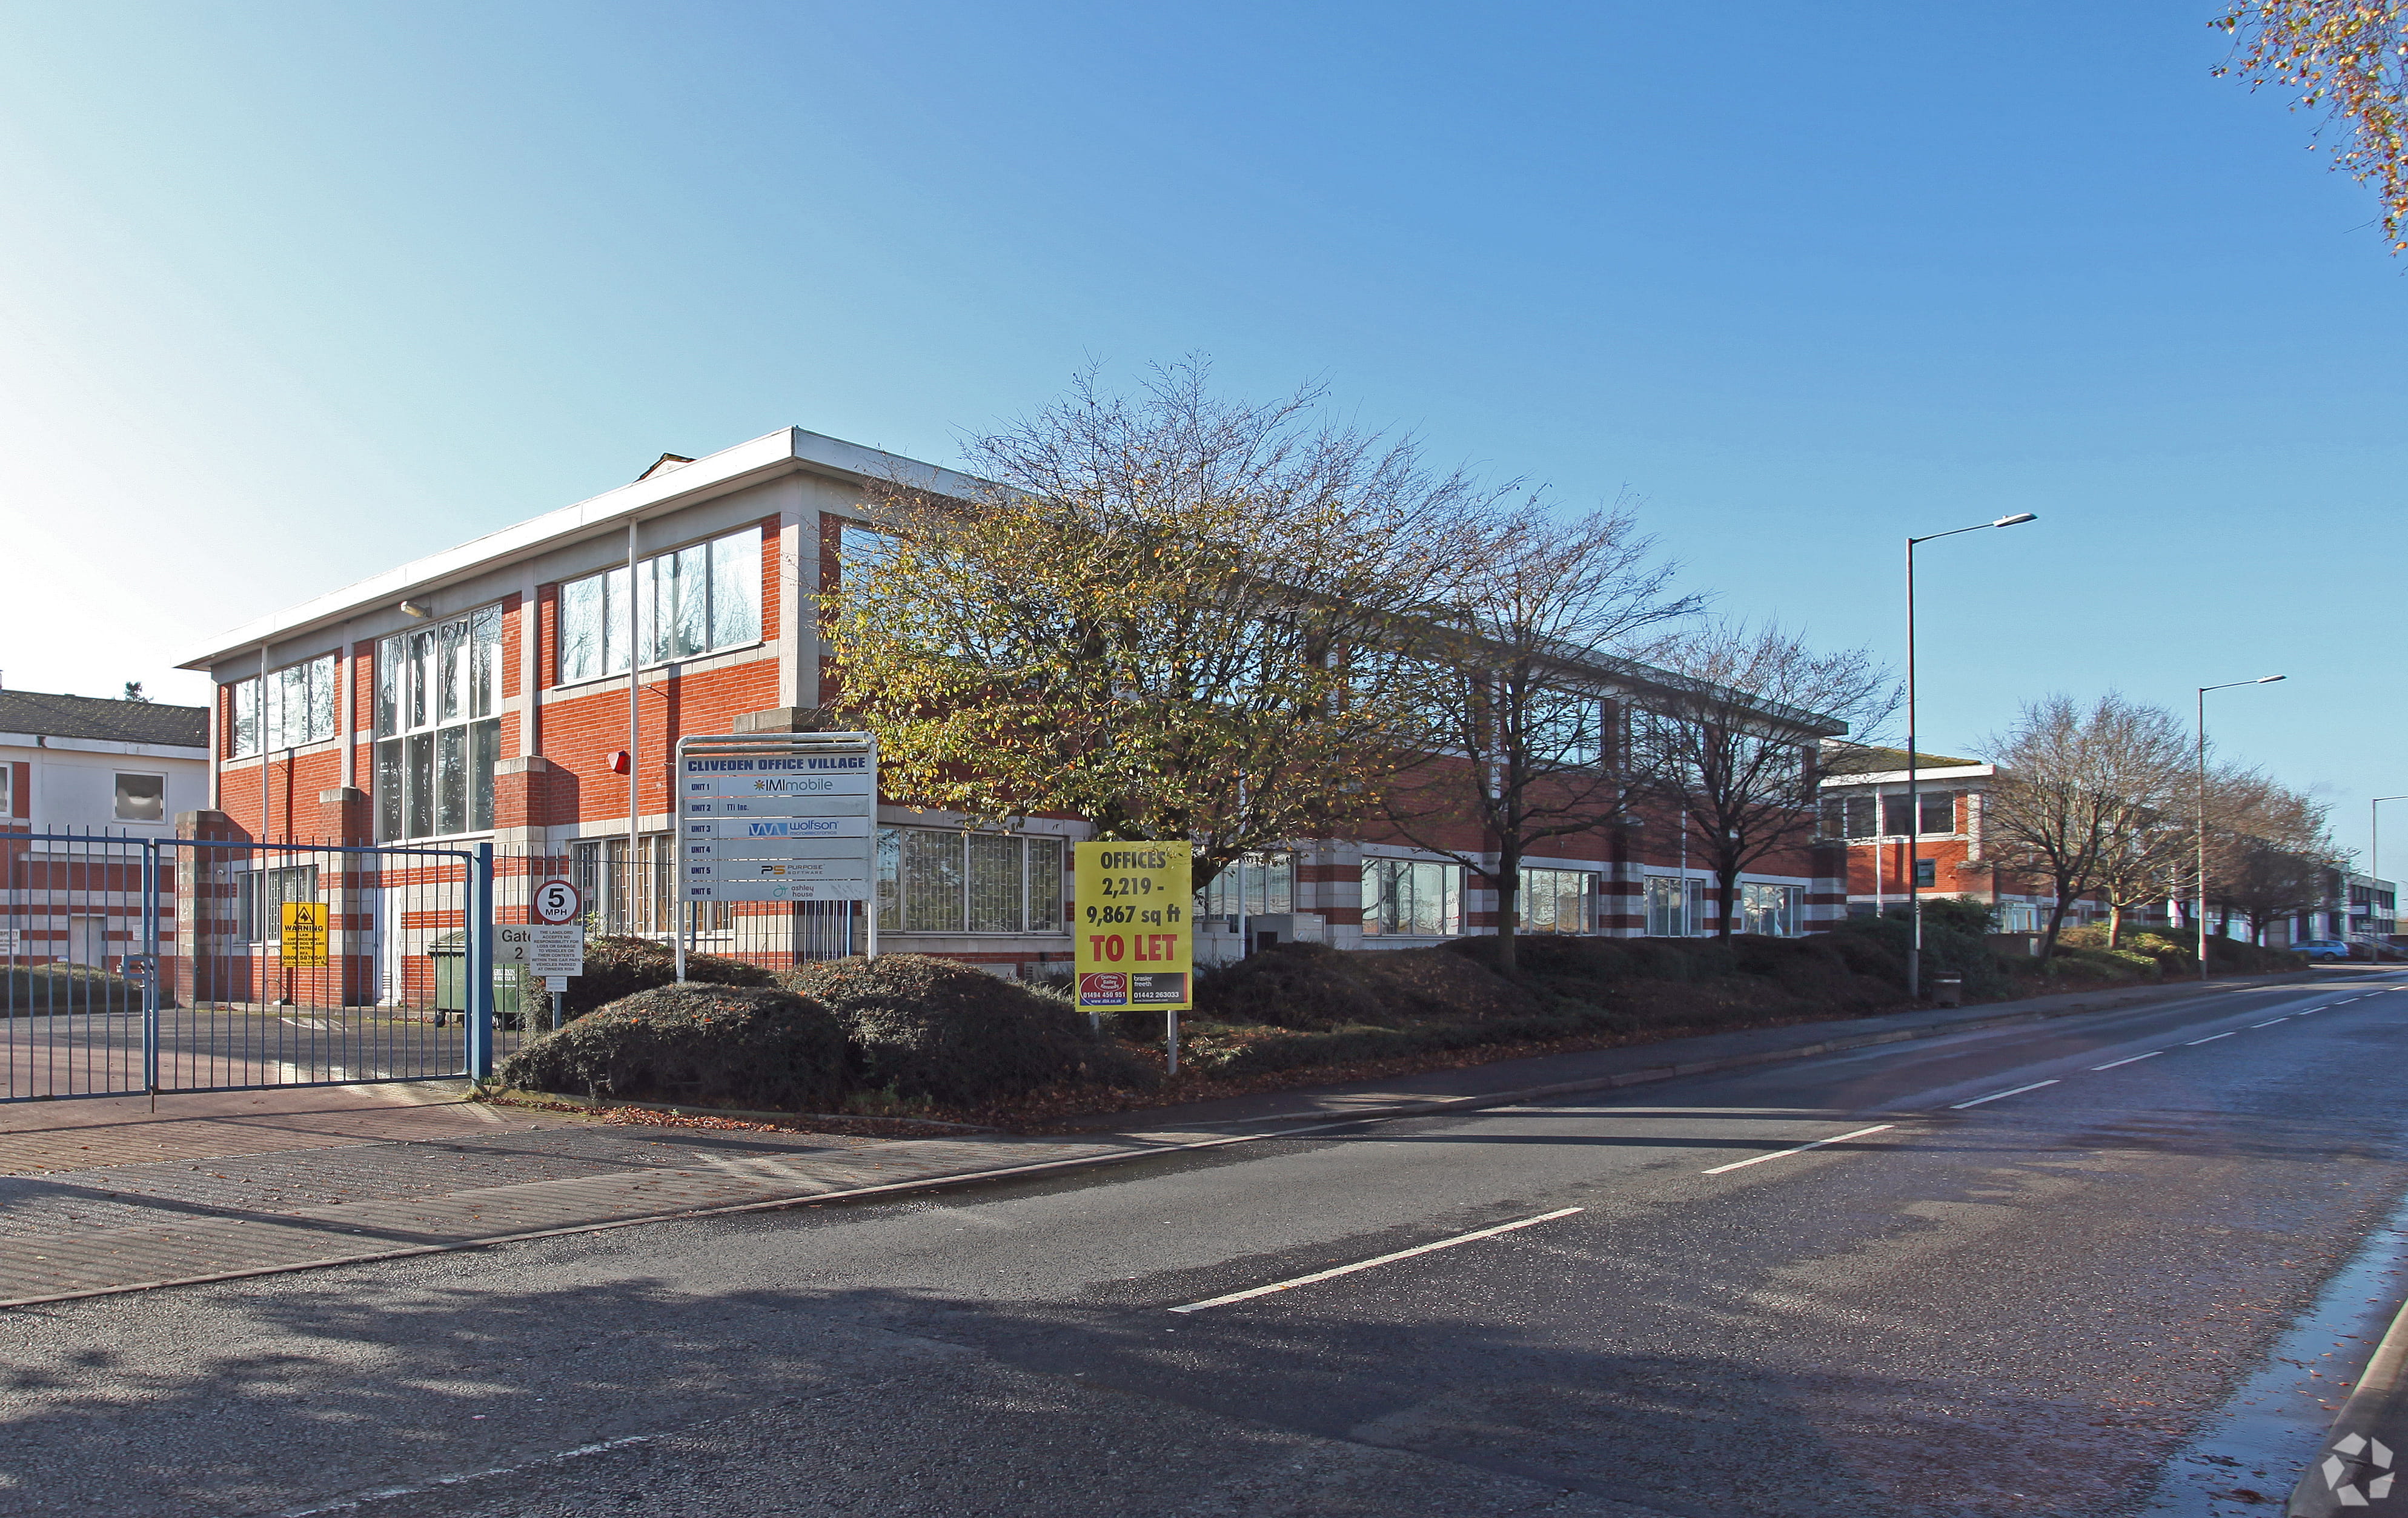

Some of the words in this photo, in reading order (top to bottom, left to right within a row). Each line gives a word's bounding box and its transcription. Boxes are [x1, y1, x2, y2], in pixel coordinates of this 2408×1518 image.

[688, 760, 754, 772] CLIVEDEN
[758, 758, 804, 771] OFFICE
[808, 757, 866, 769] VILLAGE
[789, 820, 837, 830] wolfson
[1100, 851, 1167, 869] OFFICES
[1102, 877, 1152, 899] 2,219
[548, 888, 565, 908] 5
[1086, 906, 1136, 927] 9,867
[1141, 909, 1161, 926] sq
[1166, 904, 1181, 923] ft
[502, 929, 531, 943] Gat
[514, 947, 523, 960] 2
[1089, 934, 1125, 962] TO
[1134, 933, 1178, 961] LET
